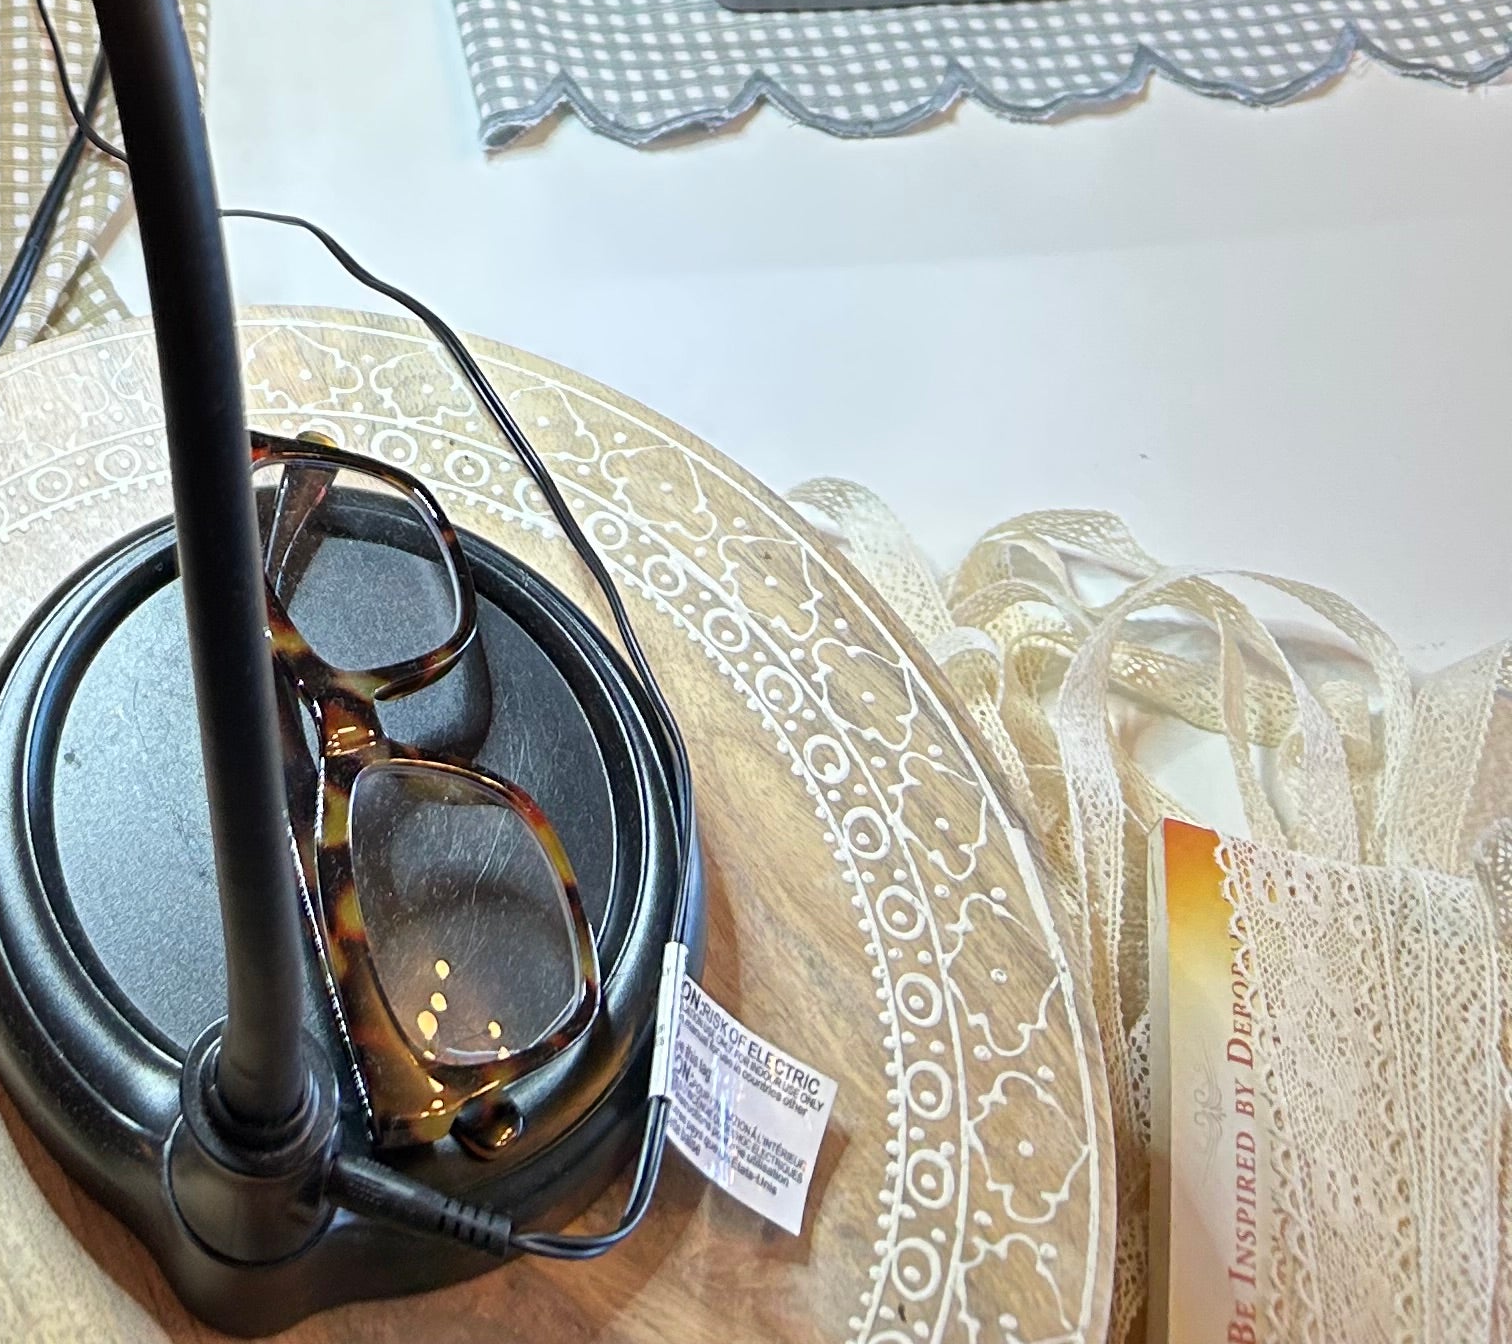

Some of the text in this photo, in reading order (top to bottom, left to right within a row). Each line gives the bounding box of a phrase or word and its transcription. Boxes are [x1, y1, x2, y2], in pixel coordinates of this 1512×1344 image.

[729, 1028, 747, 1046] OF
[748, 1042, 820, 1095] ELECTRIC
[1235, 1079, 1256, 1119] BY
[1227, 1299, 1257, 1344] BE
